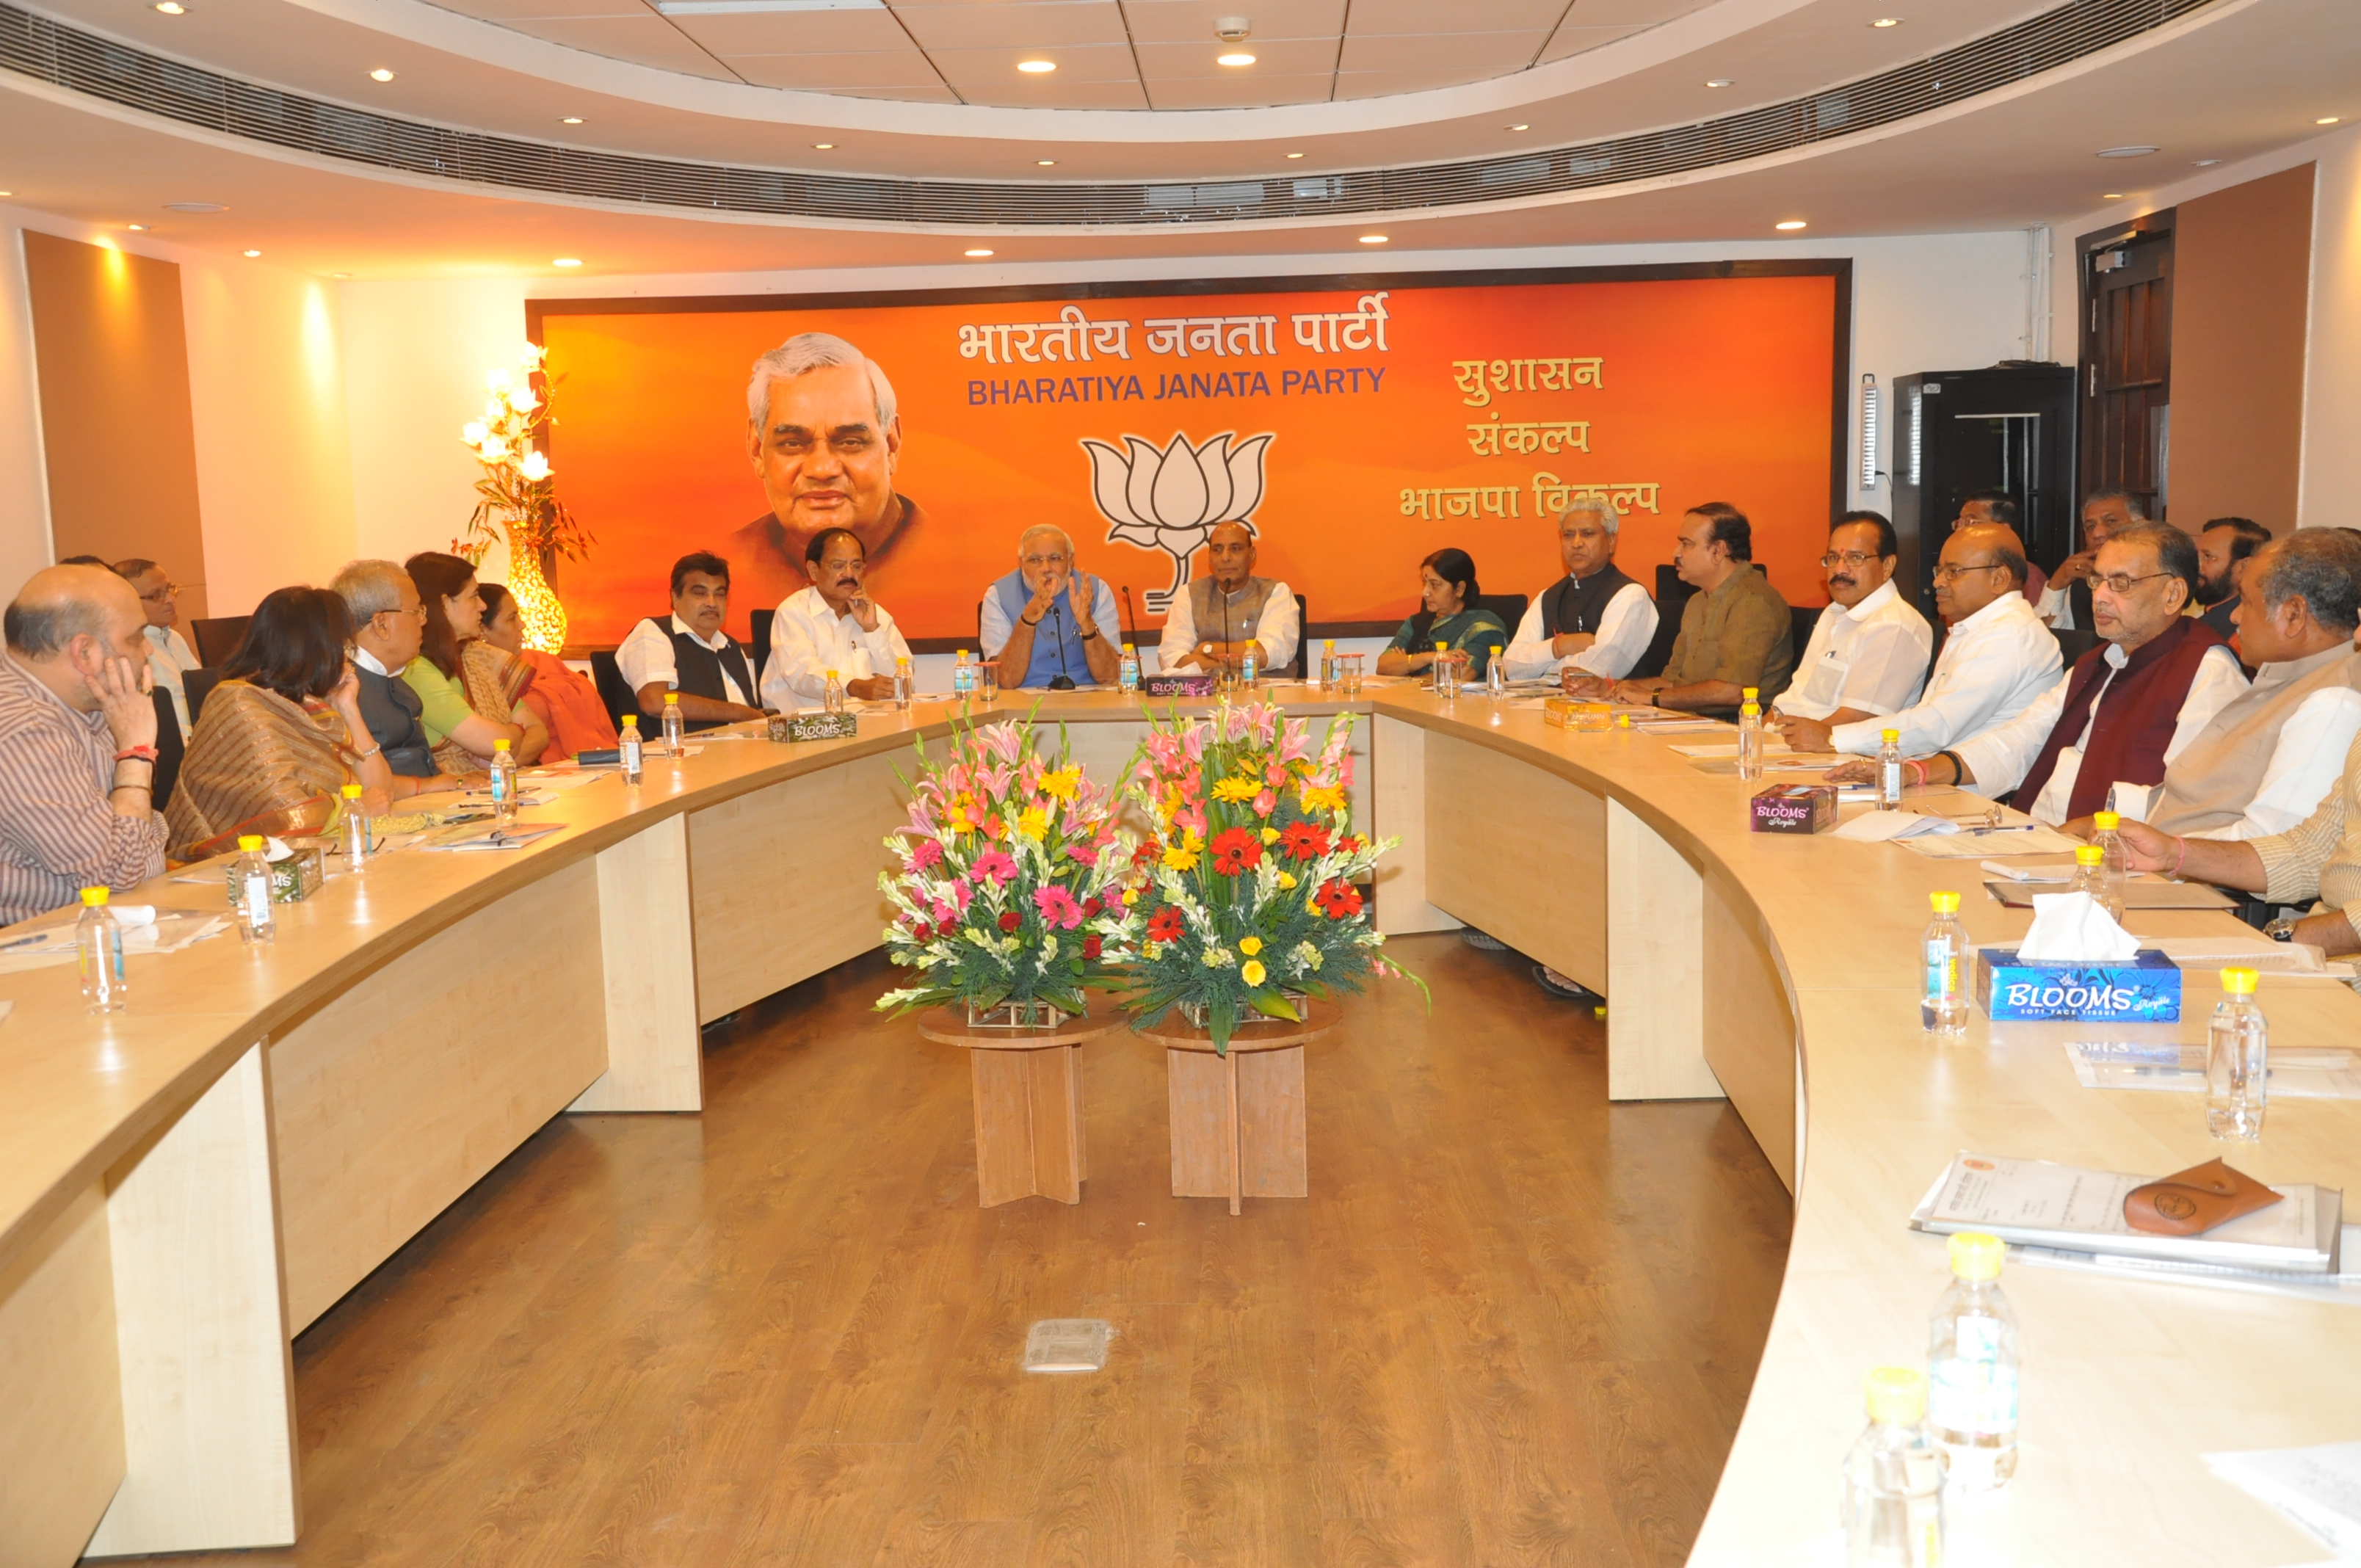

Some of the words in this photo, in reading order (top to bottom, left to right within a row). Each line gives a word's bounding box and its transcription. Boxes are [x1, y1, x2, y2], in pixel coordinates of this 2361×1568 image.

[958, 305, 1132, 364] भारतीय
[1143, 316, 1279, 357] जनता
[1291, 291, 1390, 354] पार्टी
[968, 375, 1145, 405] BHARATIYA
[1153, 371, 1272, 399] JANATA
[1282, 367, 1386, 395] PARTY
[1452, 357, 1605, 407] सुशासन
[1466, 411, 1592, 457] संकल्प
[1399, 485, 1521, 520] भाजपा
[794, 722, 841, 736] BLOOMS
[1755, 806, 1807, 819] BLOOMS
[1948, 958, 1958, 992] vedica
[2005, 984, 2134, 1011] BLOOMS
